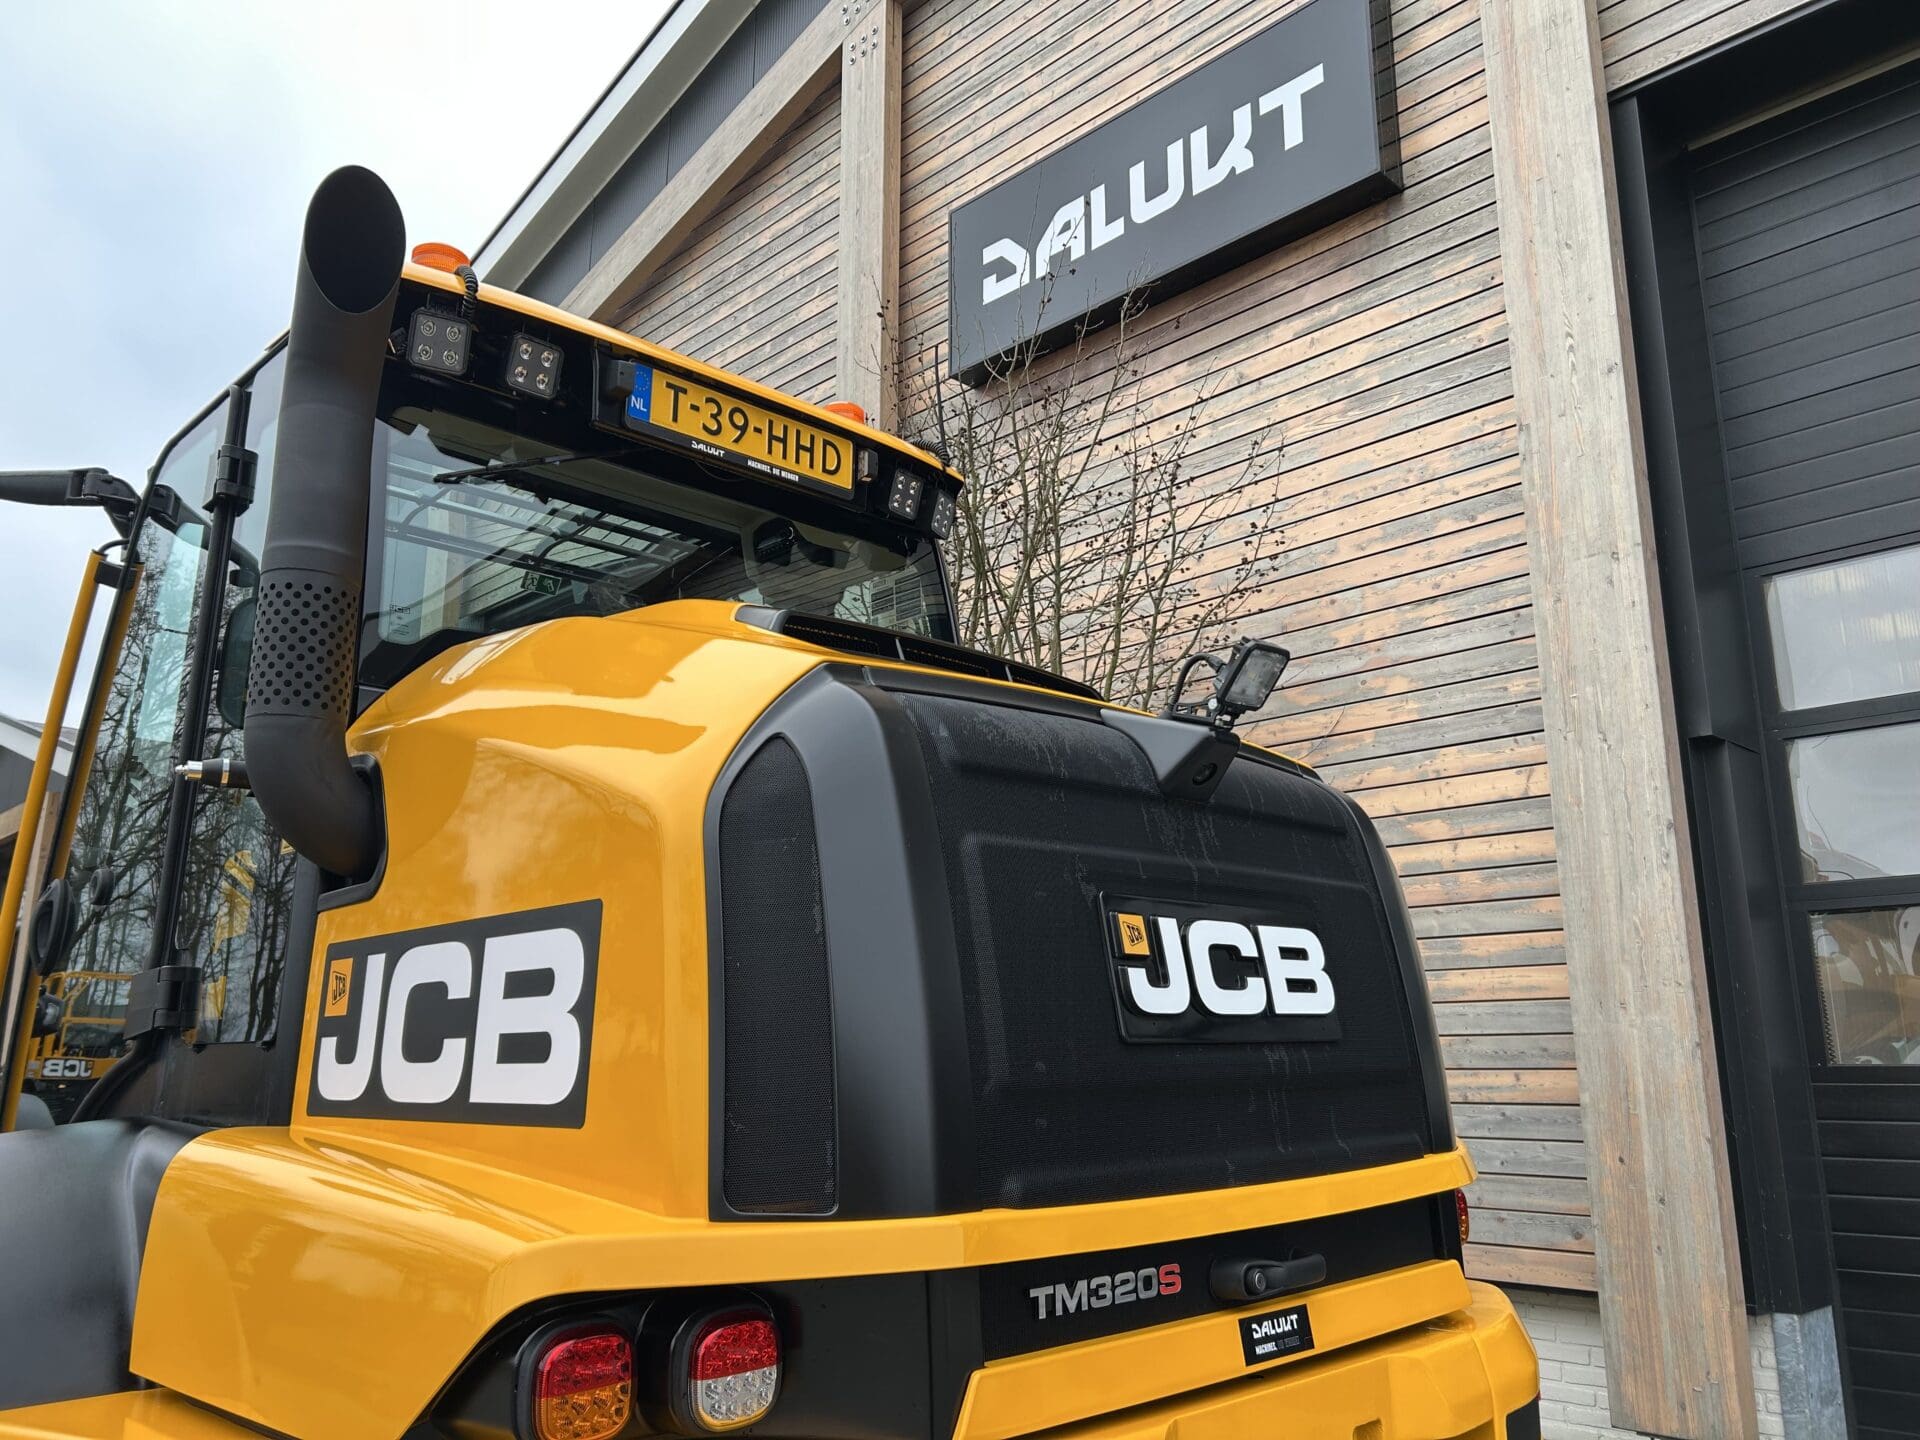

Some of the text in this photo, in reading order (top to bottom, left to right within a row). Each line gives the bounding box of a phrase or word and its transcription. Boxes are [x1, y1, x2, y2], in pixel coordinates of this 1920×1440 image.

[631, 395, 647, 411] NL
[665, 381, 842, 475] T-39-HHD
[1127, 916, 1336, 1016] JCB
[317, 927, 585, 1106] JCB
[1029, 1263, 1182, 1321] TM320S
